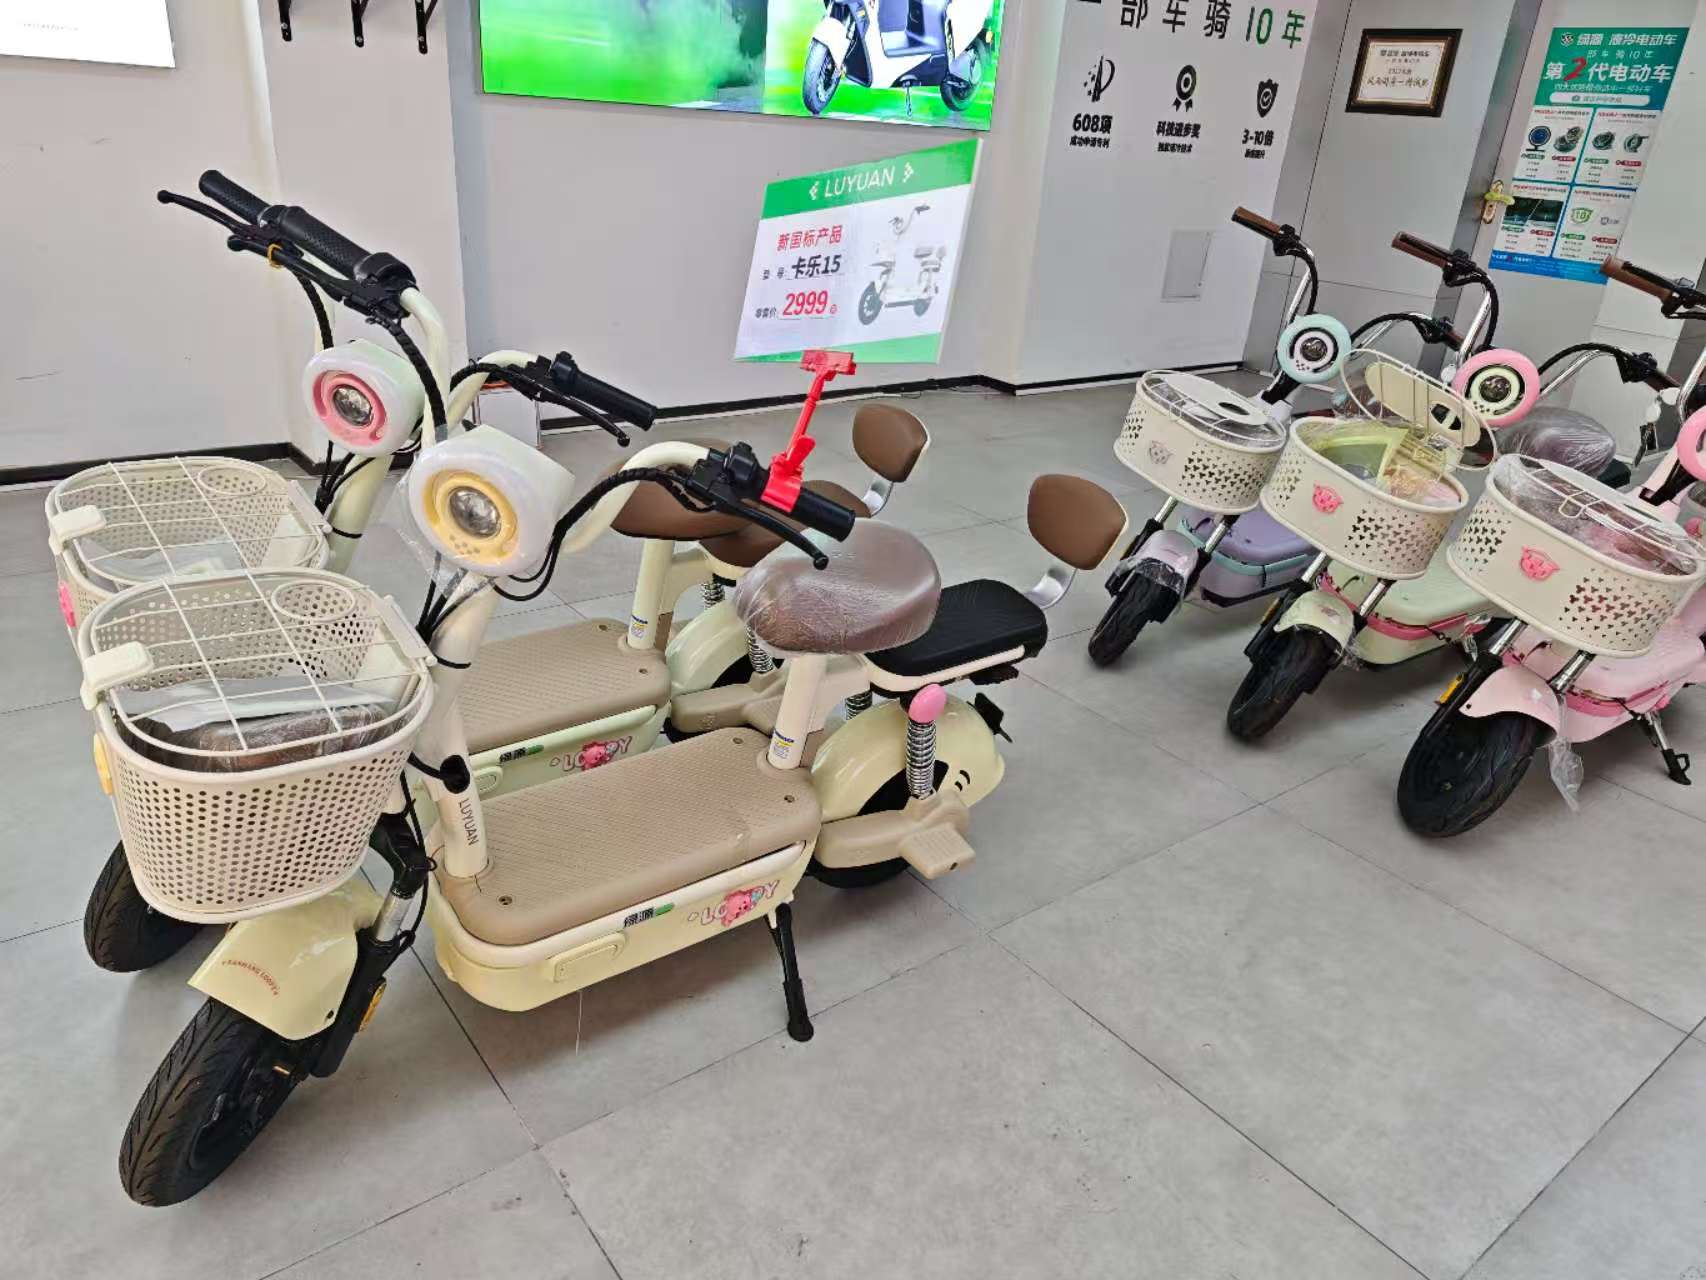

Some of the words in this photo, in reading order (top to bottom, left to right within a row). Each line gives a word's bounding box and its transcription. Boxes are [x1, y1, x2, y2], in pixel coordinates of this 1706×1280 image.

[1543, 56, 1674, 84] 第2代电动车
[1072, 113, 1113, 134] 608项
[824, 165, 896, 198] LUYUAN
[776, 224, 843, 252] 新国标产品
[791, 254, 842, 279] 卡乐15
[782, 289, 829, 317] 2999
[458, 797, 479, 847] LUYUAN
